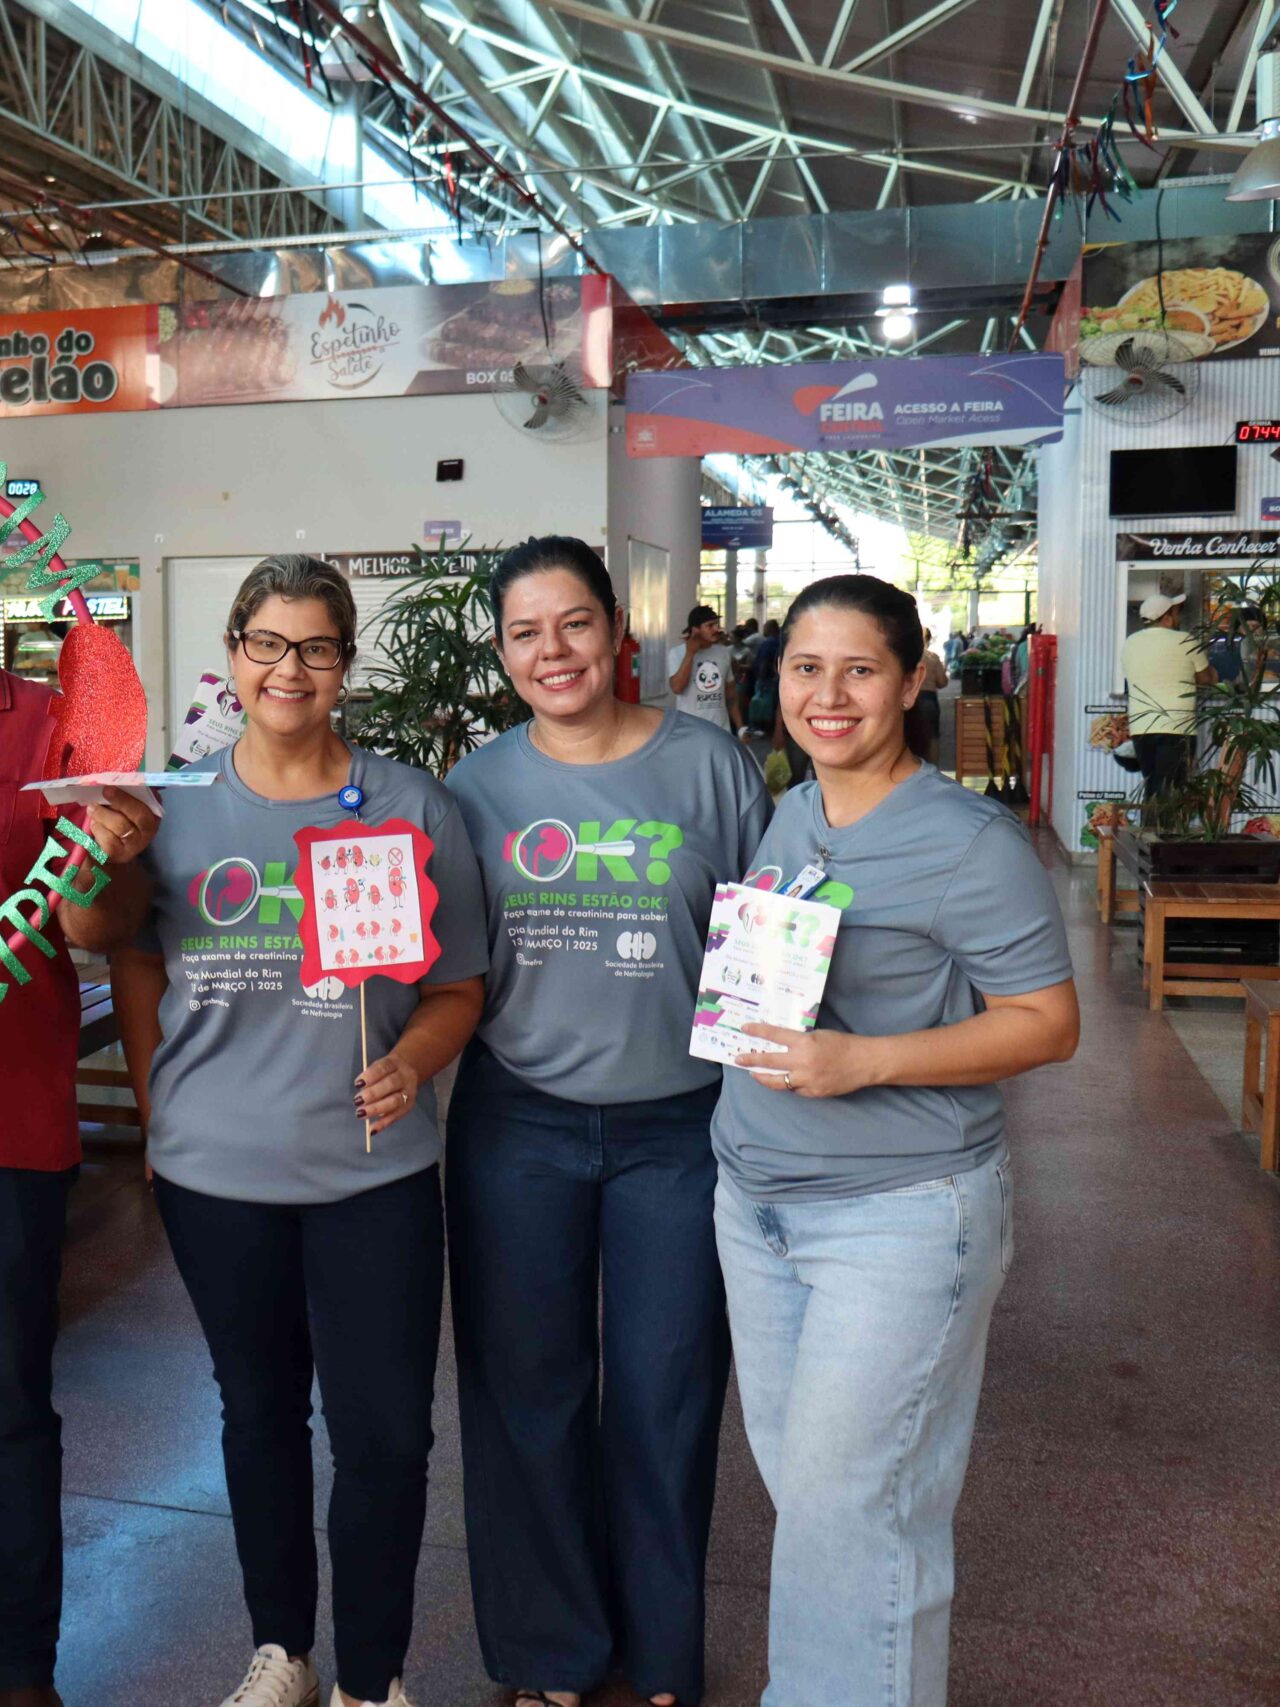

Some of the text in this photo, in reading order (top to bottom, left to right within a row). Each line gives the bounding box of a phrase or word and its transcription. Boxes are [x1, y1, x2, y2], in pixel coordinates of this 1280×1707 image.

[56, 328, 93, 354] do
[310, 315, 401, 362] Espetinho
[466, 371, 497, 385] BOX
[821, 402, 883, 421] FEIRA
[894, 400, 1004, 414] ACESSO A FEIRA
[705, 509, 748, 517] ALAMEDA
[1151, 536, 1277, 556] Venha Conhecer
[349, 554, 411, 576] MELHOR
[539, 892, 577, 907] RINS
[581, 890, 634, 908] ESTÃO
[504, 911, 525, 920] Faça
[553, 907, 565, 917] de
[568, 909, 614, 919] creatinina
[616, 912, 638, 922] para
[640, 913, 668, 922] saber!
[508, 927, 525, 937] Dia
[562, 926, 576, 936] do
[579, 927, 598, 938] Rim
[181, 933, 303, 951] SEUS RINS ESTÃ
[526, 938, 562, 949] MARÇO
[573, 940, 598, 951] 2025
[181, 953, 200, 963] Faça
[202, 953, 231, 961] exame
[234, 951, 247, 960] de
[250, 951, 297, 961] creatinina
[604, 960, 638, 968] Sociedade
[185, 967, 282, 980] Dia Mundial do Rim
[624, 970, 655, 979] Nefrologia
[198, 984, 210, 992] de
[212, 981, 247, 992] MARÇO
[258, 981, 283, 991] 2025
[291, 998, 354, 1010] Sociedade Brasileira
[310, 1009, 343, 1019] Nefrologia
